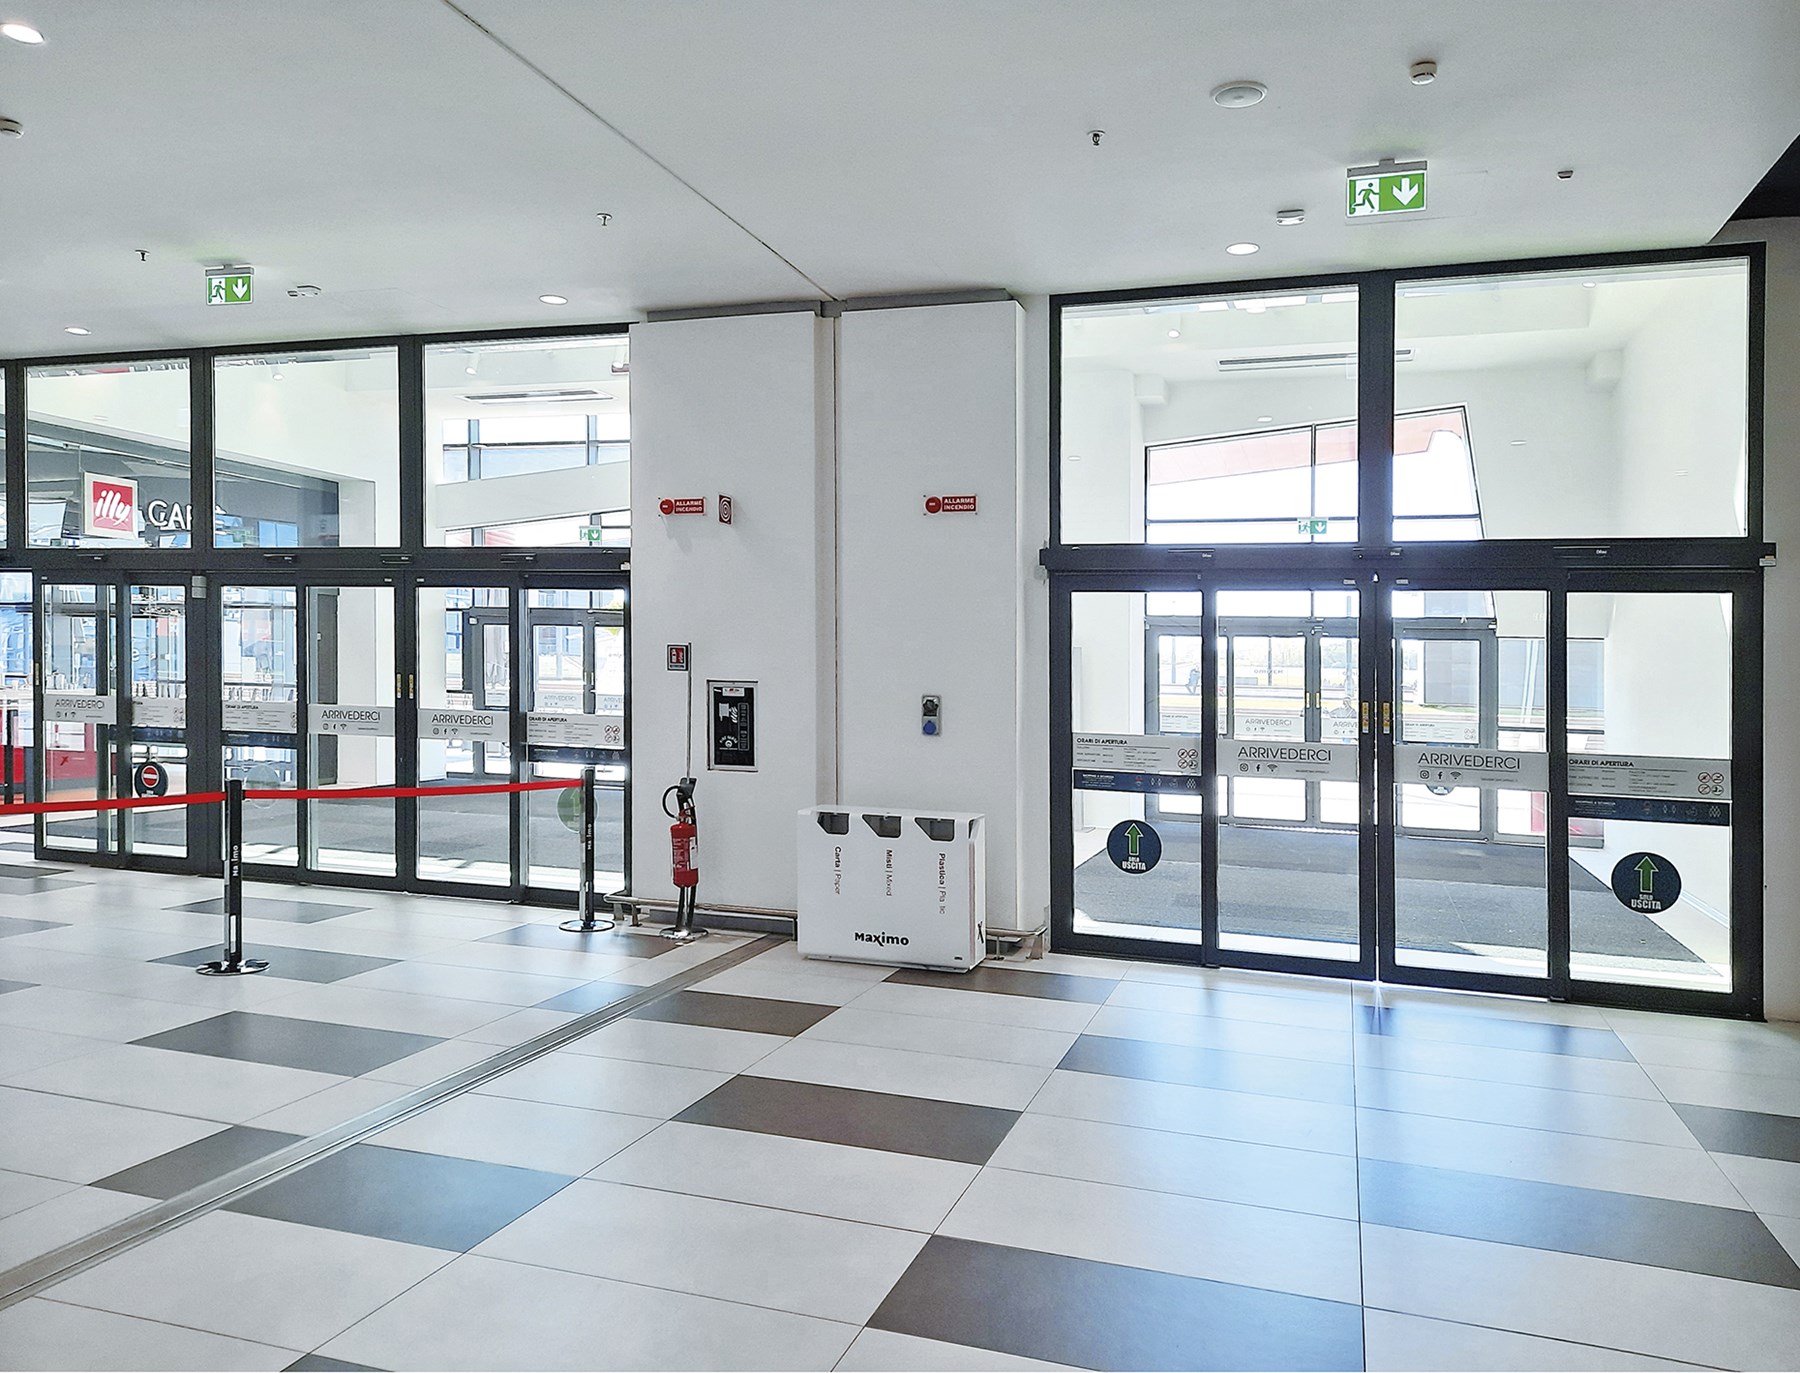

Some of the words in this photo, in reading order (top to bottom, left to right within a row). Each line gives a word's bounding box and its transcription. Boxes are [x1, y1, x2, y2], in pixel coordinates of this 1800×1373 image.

[94, 489, 131, 526] illy
[321, 709, 381, 721] ARRIVEDERCI
[431, 713, 494, 726] ARRIVEDERCI
[1238, 747, 1331, 762] ARRIVEDERCI
[1418, 753, 1520, 769] ARRIVEDERCI
[231, 845, 239, 877] Maimo
[1122, 861, 1146, 870] USCITA
[1631, 899, 1662, 910] USCITA
[854, 932, 910, 947] Maximo
